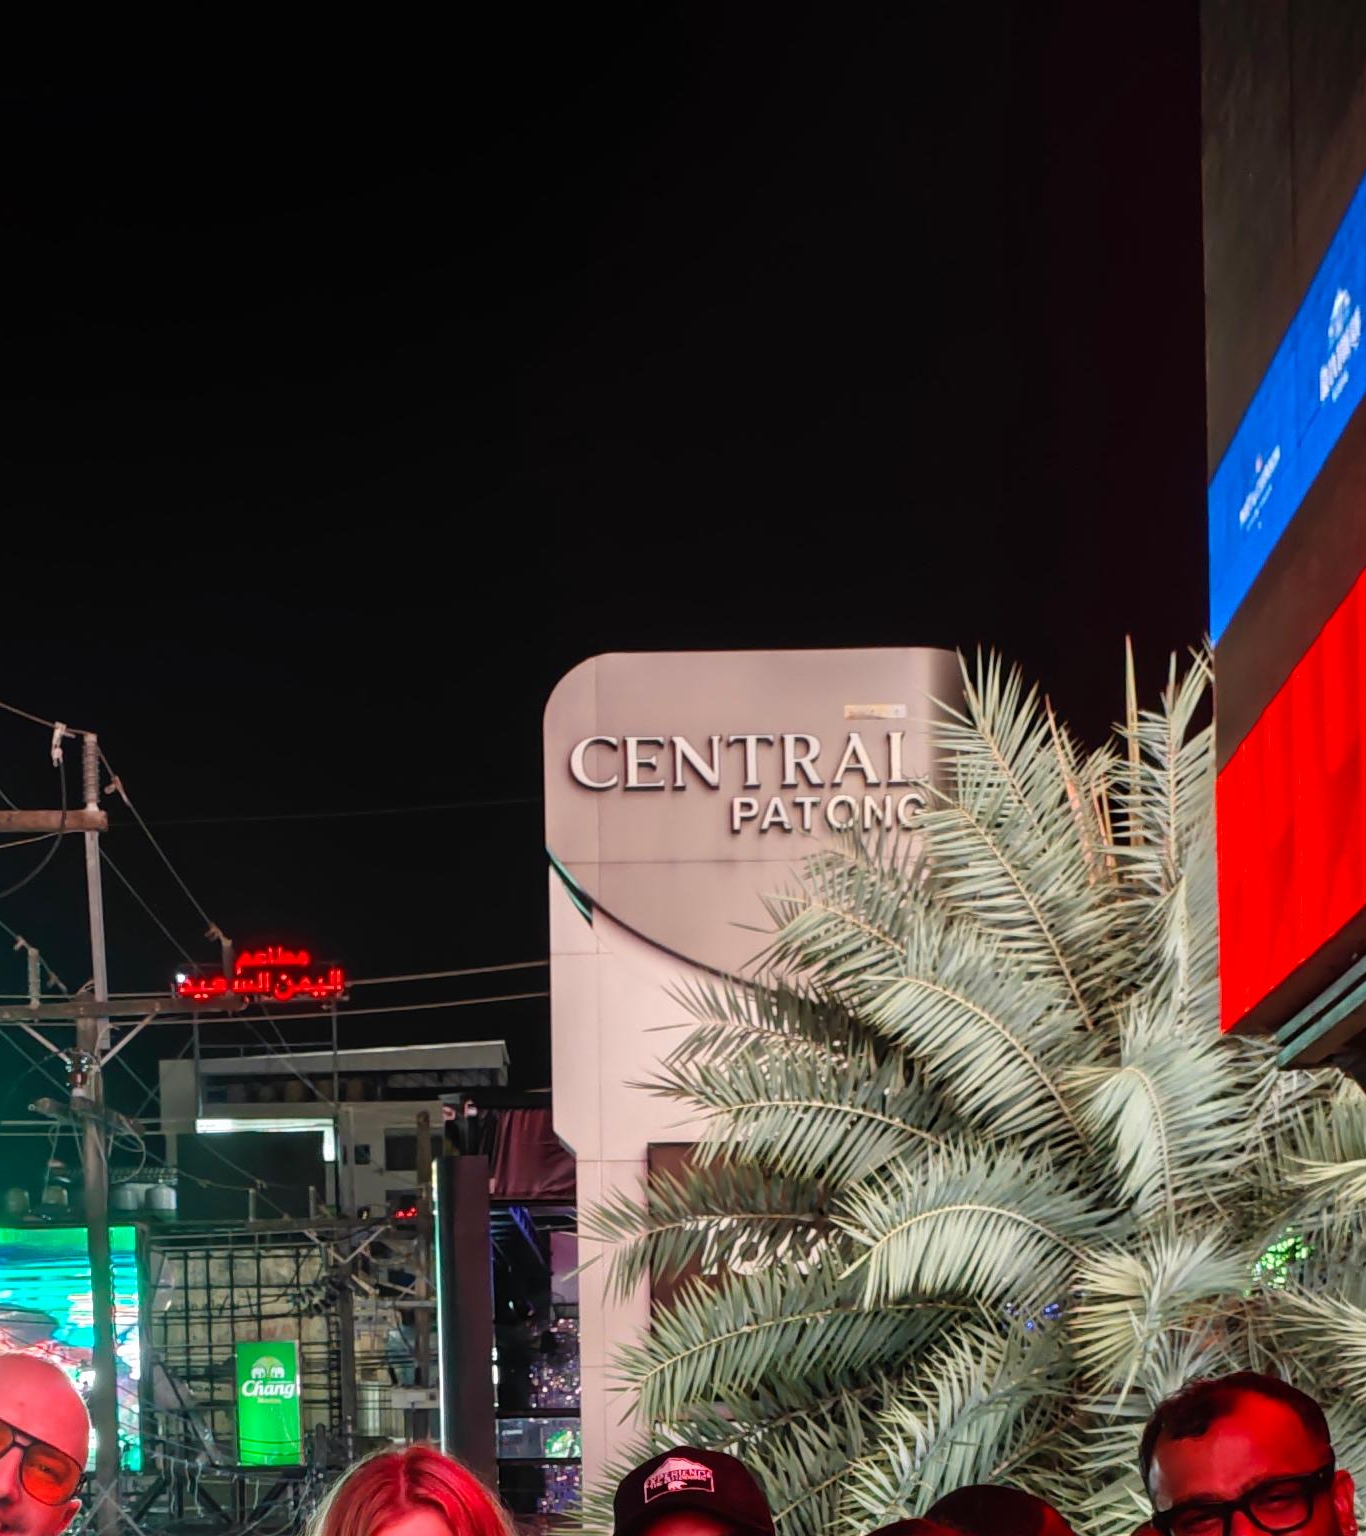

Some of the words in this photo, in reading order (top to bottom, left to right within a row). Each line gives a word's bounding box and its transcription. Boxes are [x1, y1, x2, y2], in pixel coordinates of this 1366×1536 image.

[569, 731, 929, 790] CENTRAL
[731, 793, 928, 833] PATONG
[241, 1379, 296, 1399] Chang
